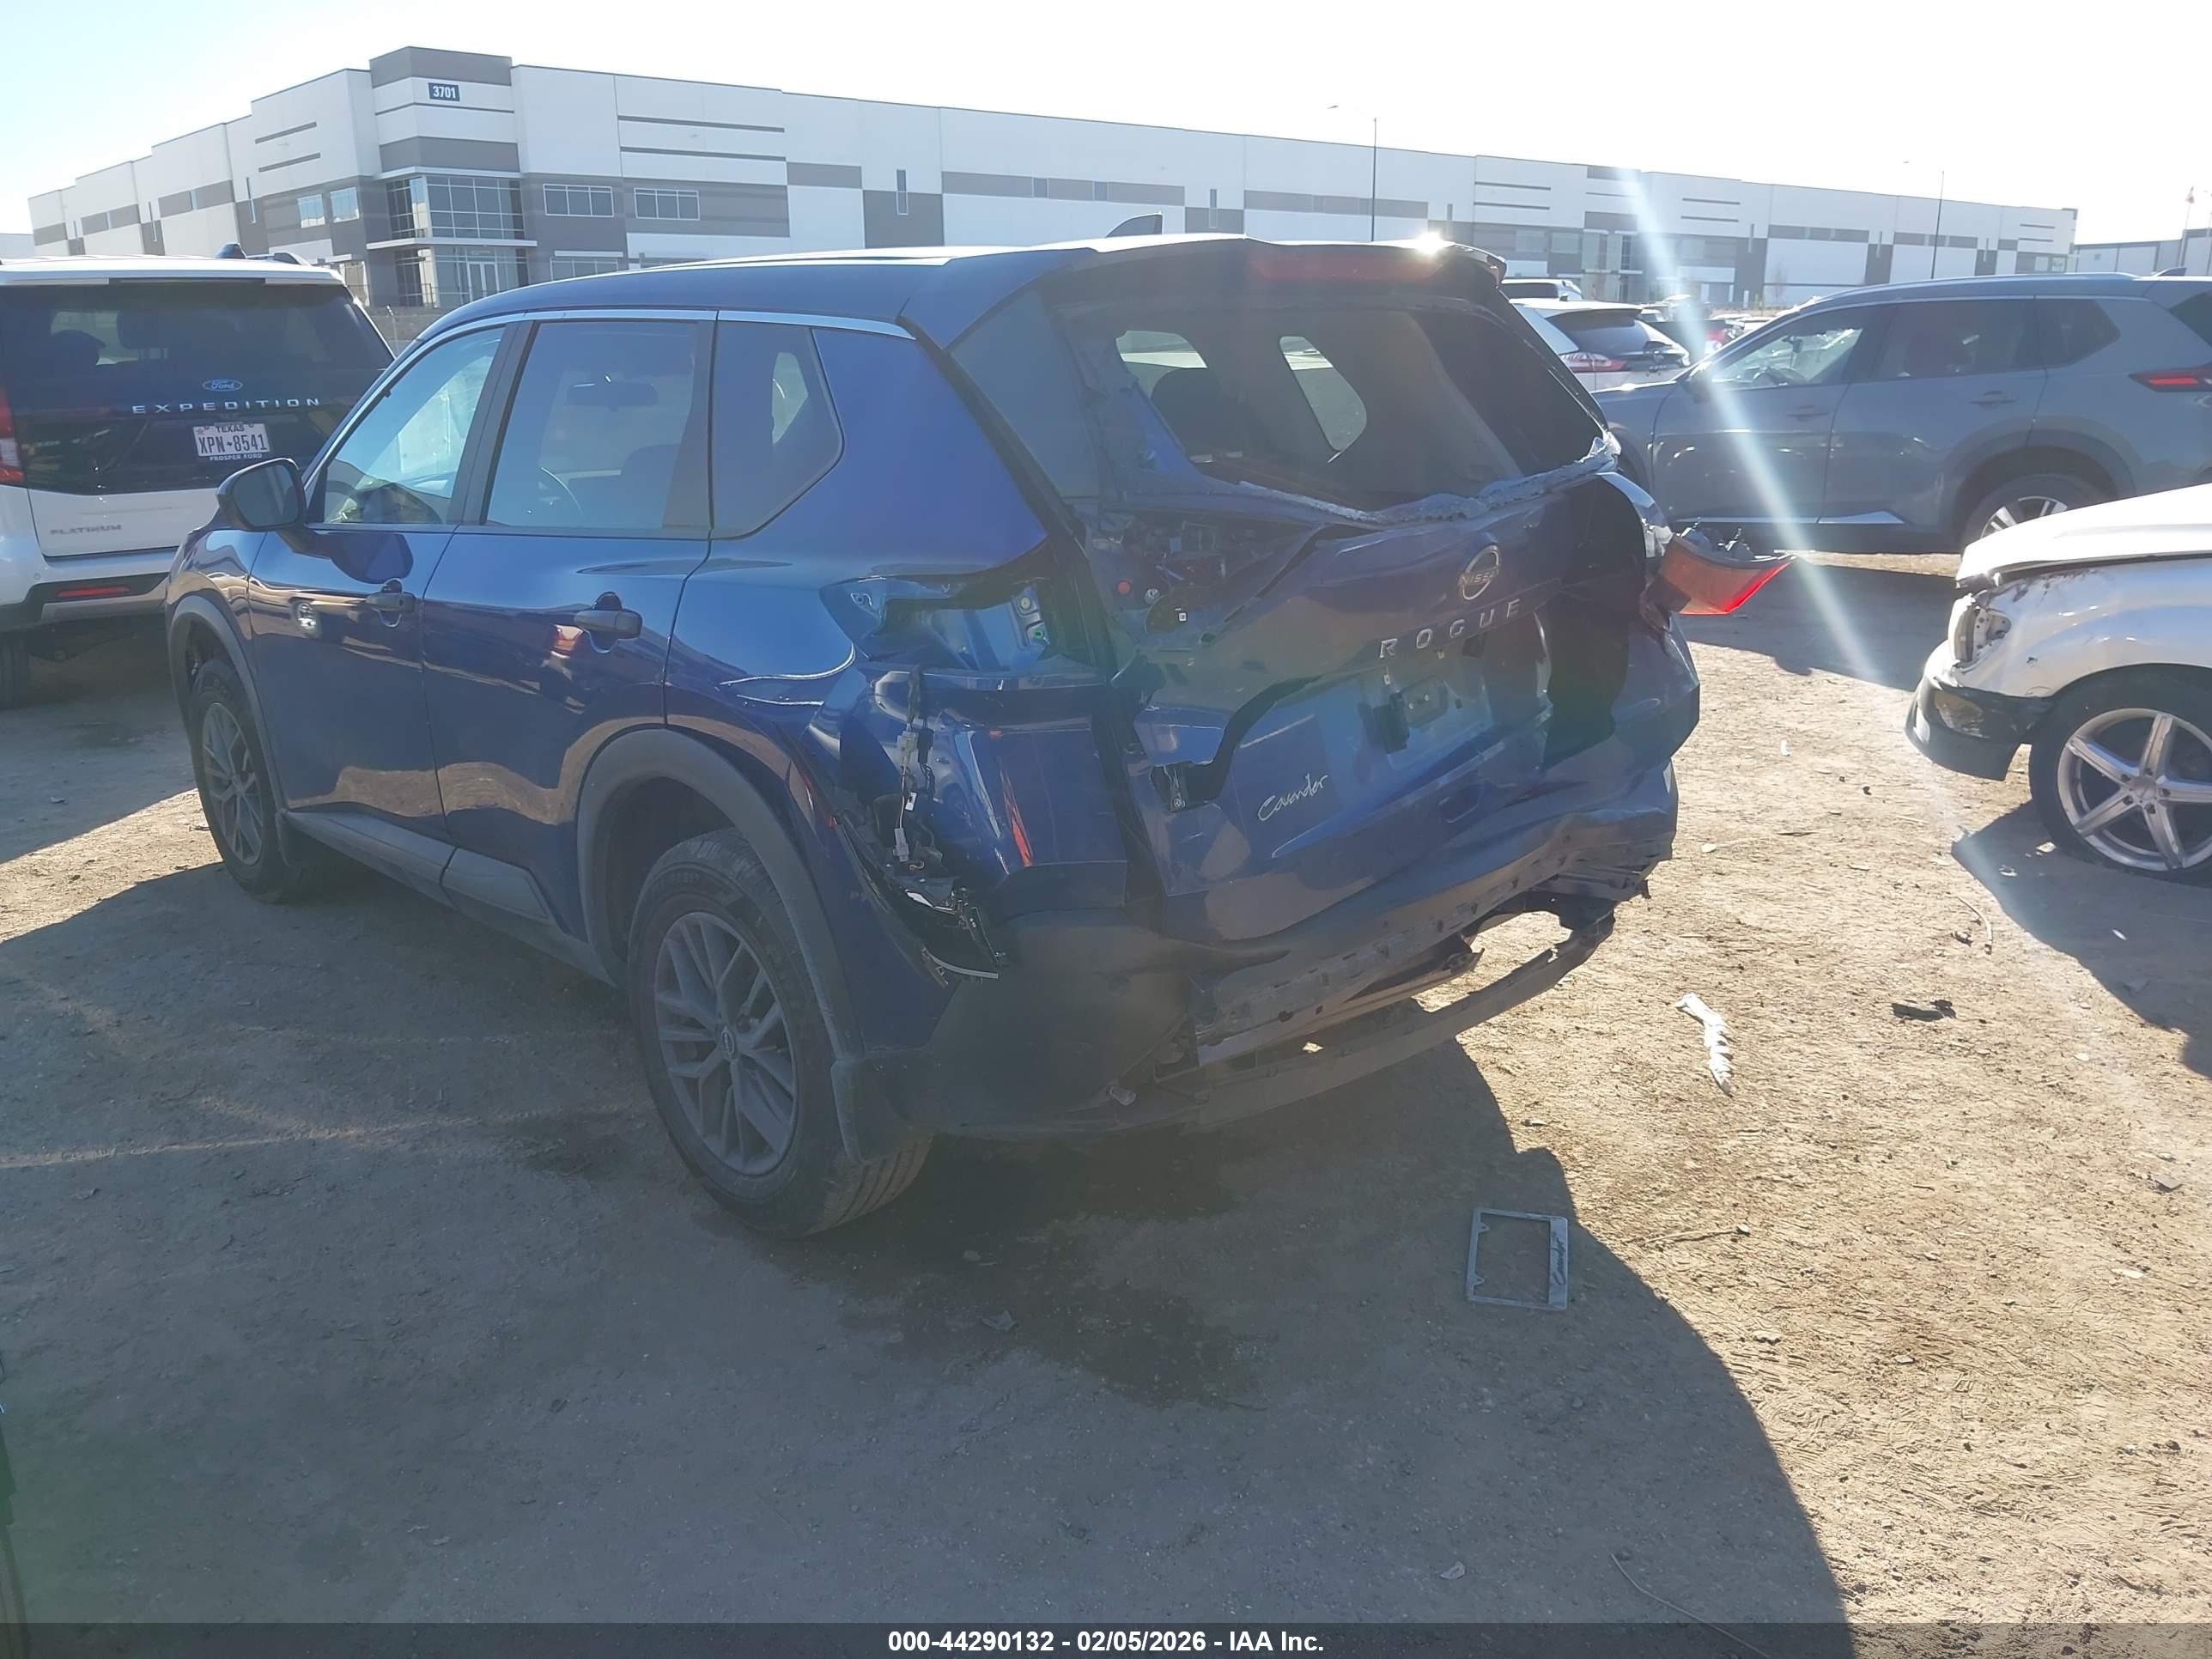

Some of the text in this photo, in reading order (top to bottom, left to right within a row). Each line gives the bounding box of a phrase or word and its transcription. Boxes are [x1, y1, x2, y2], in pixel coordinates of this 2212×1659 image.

[432, 85, 456, 99] 3701
[131, 398, 320, 414] EXPEDITION
[1379, 598, 1521, 659] ROGUE
[1257, 773, 1329, 821] Cavender
